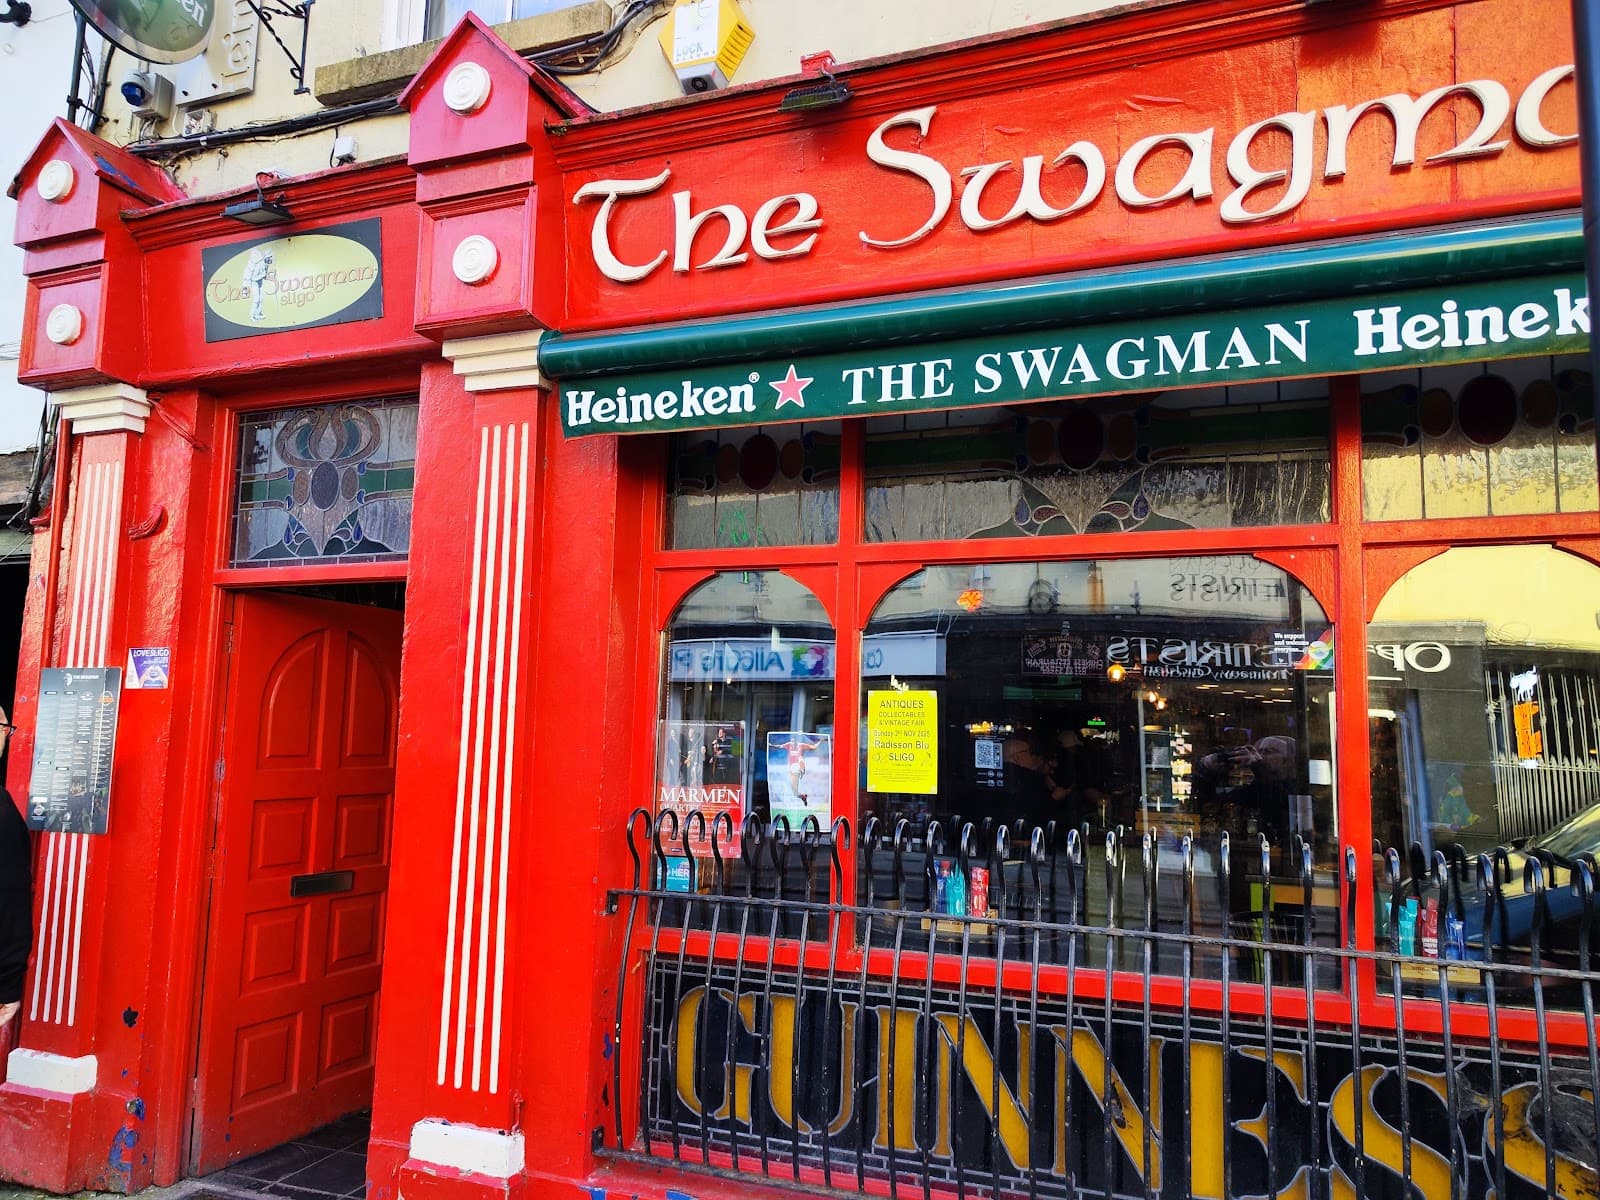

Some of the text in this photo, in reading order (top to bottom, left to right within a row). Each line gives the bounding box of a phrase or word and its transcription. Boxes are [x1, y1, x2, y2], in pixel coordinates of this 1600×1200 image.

[572, 168, 823, 282] The
[210, 265, 374, 303] The Swagman
[842, 358, 954, 405] THE
[974, 319, 1311, 394] SWAGMAN
[880, 700, 924, 709] ANTIQUES
[875, 740, 929, 749] Radisson Blu
[889, 753, 915, 762] SLIGO
